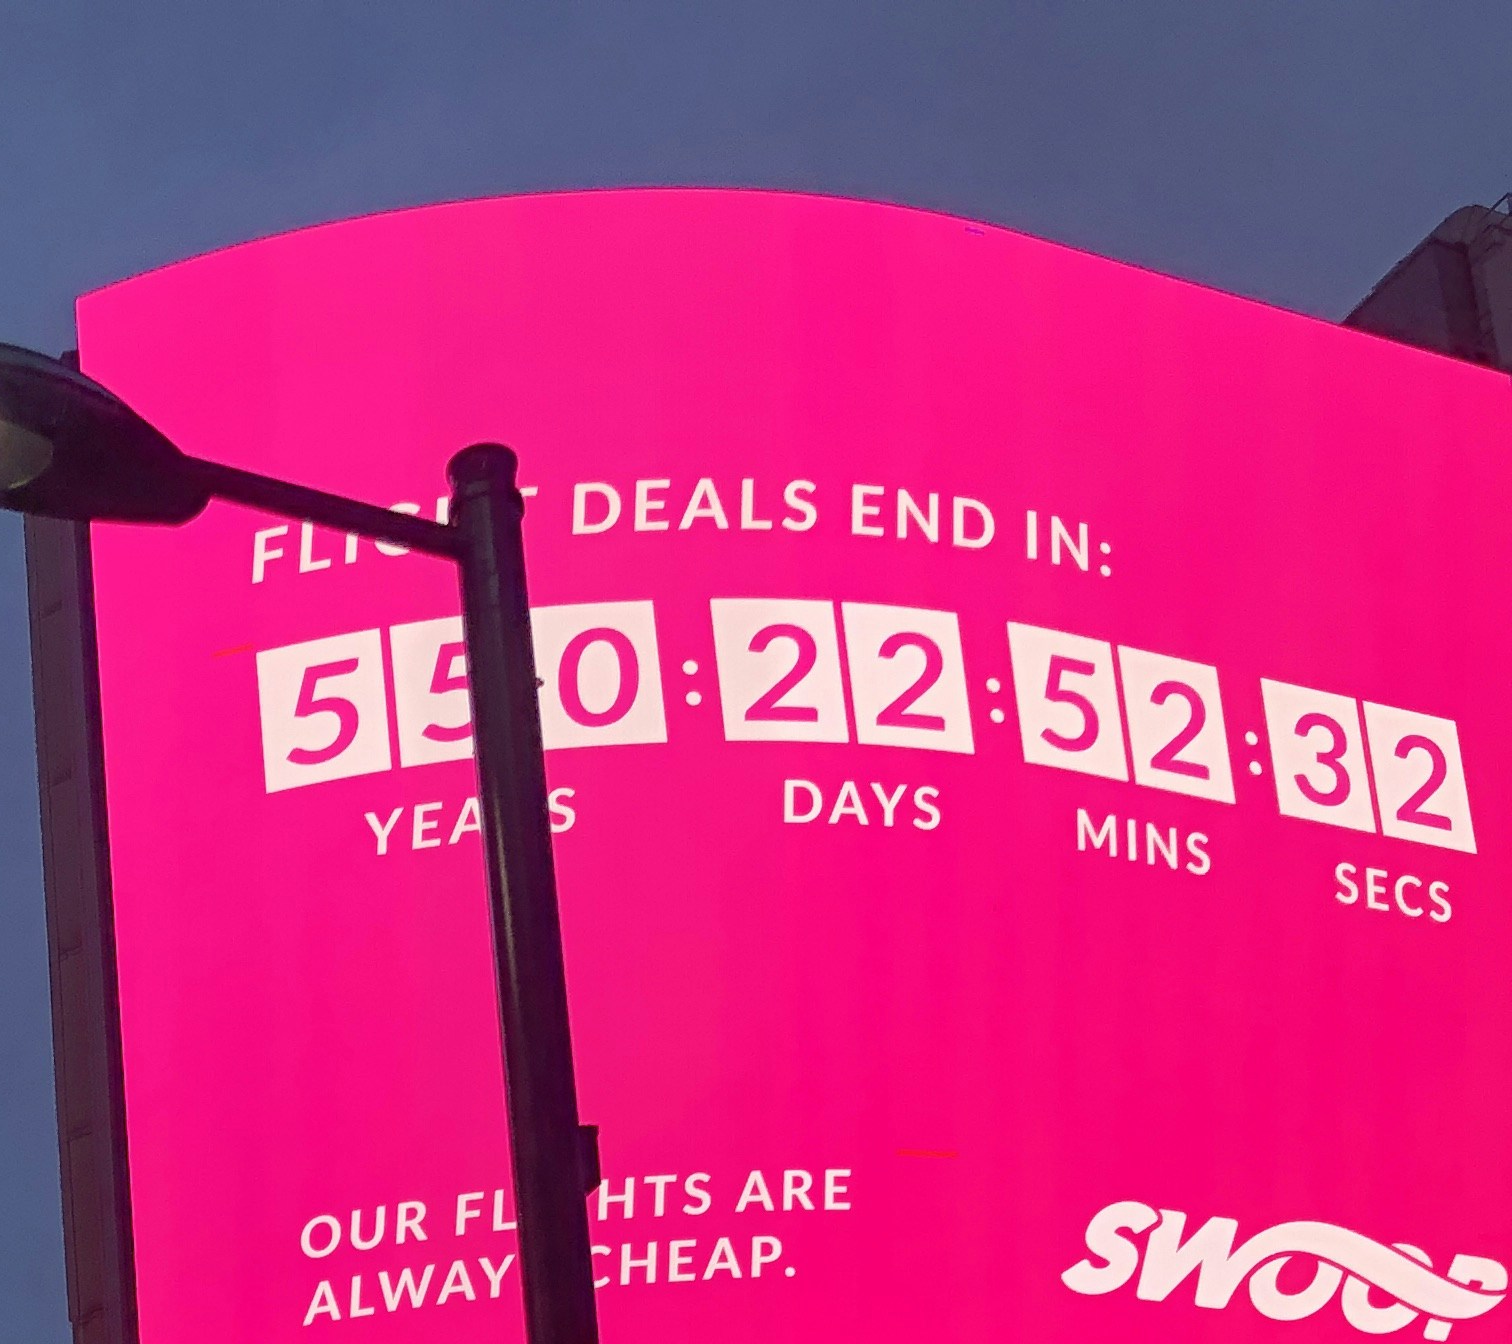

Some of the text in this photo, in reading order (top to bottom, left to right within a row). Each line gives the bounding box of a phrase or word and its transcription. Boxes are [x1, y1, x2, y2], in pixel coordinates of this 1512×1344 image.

[572, 477, 819, 535] DEALS
[850, 484, 996, 549] END
[1026, 510, 1112, 577] IN:
[365, 779, 1452, 923] YEAS DAYS MINS SECS
[299, 1169, 852, 1259] OUR FLHTS ARE
[302, 1254, 516, 1326] ALWAY
